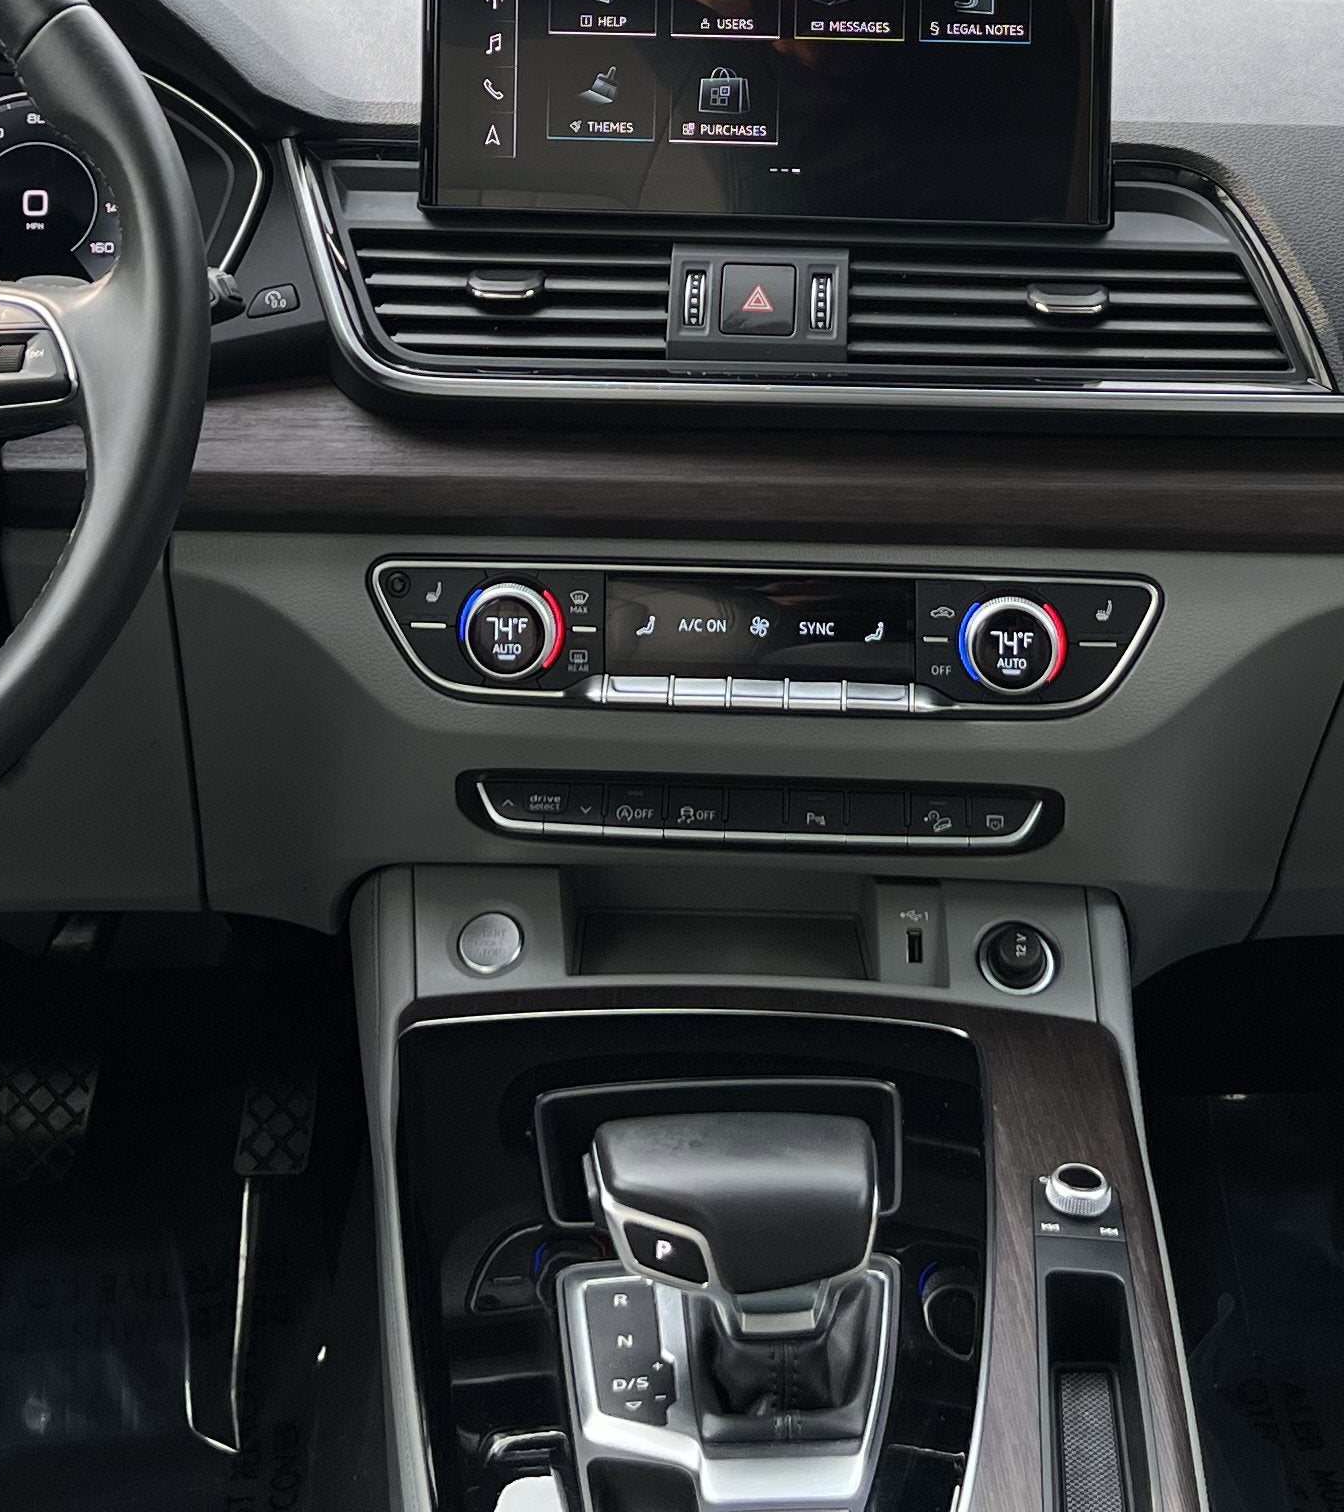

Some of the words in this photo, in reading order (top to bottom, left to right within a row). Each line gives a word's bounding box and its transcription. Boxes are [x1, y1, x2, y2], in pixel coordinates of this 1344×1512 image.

[598, 16, 626, 27] HELP
[717, 19, 754, 30] USERS
[829, 22, 890, 33] MESSAGES
[946, 24, 982, 35] LEGAL
[985, 24, 1024, 35] NOTES
[588, 121, 634, 132] THEMES
[700, 124, 766, 136] PURCHASES
[22, 189, 48, 217] 0
[90, 242, 114, 253] 160
[570, 606, 588, 614] MAX
[678, 619, 702, 632] A/C
[706, 619, 726, 632] ON
[799, 621, 834, 635] SYNC
[493, 644, 521, 655] AUTO
[568, 664, 589, 672] REAR
[997, 658, 1026, 668] AUTO
[931, 665, 952, 675] OFF
[529, 793, 561, 803] drive
[529, 802, 561, 811] select
[634, 808, 654, 820] OFF
[696, 809, 715, 821] OFF
[656, 1240, 672, 1260] P
[614, 1294, 628, 1307] R
[617, 1335, 633, 1348] N
[612, 1376, 649, 1392] D/S
